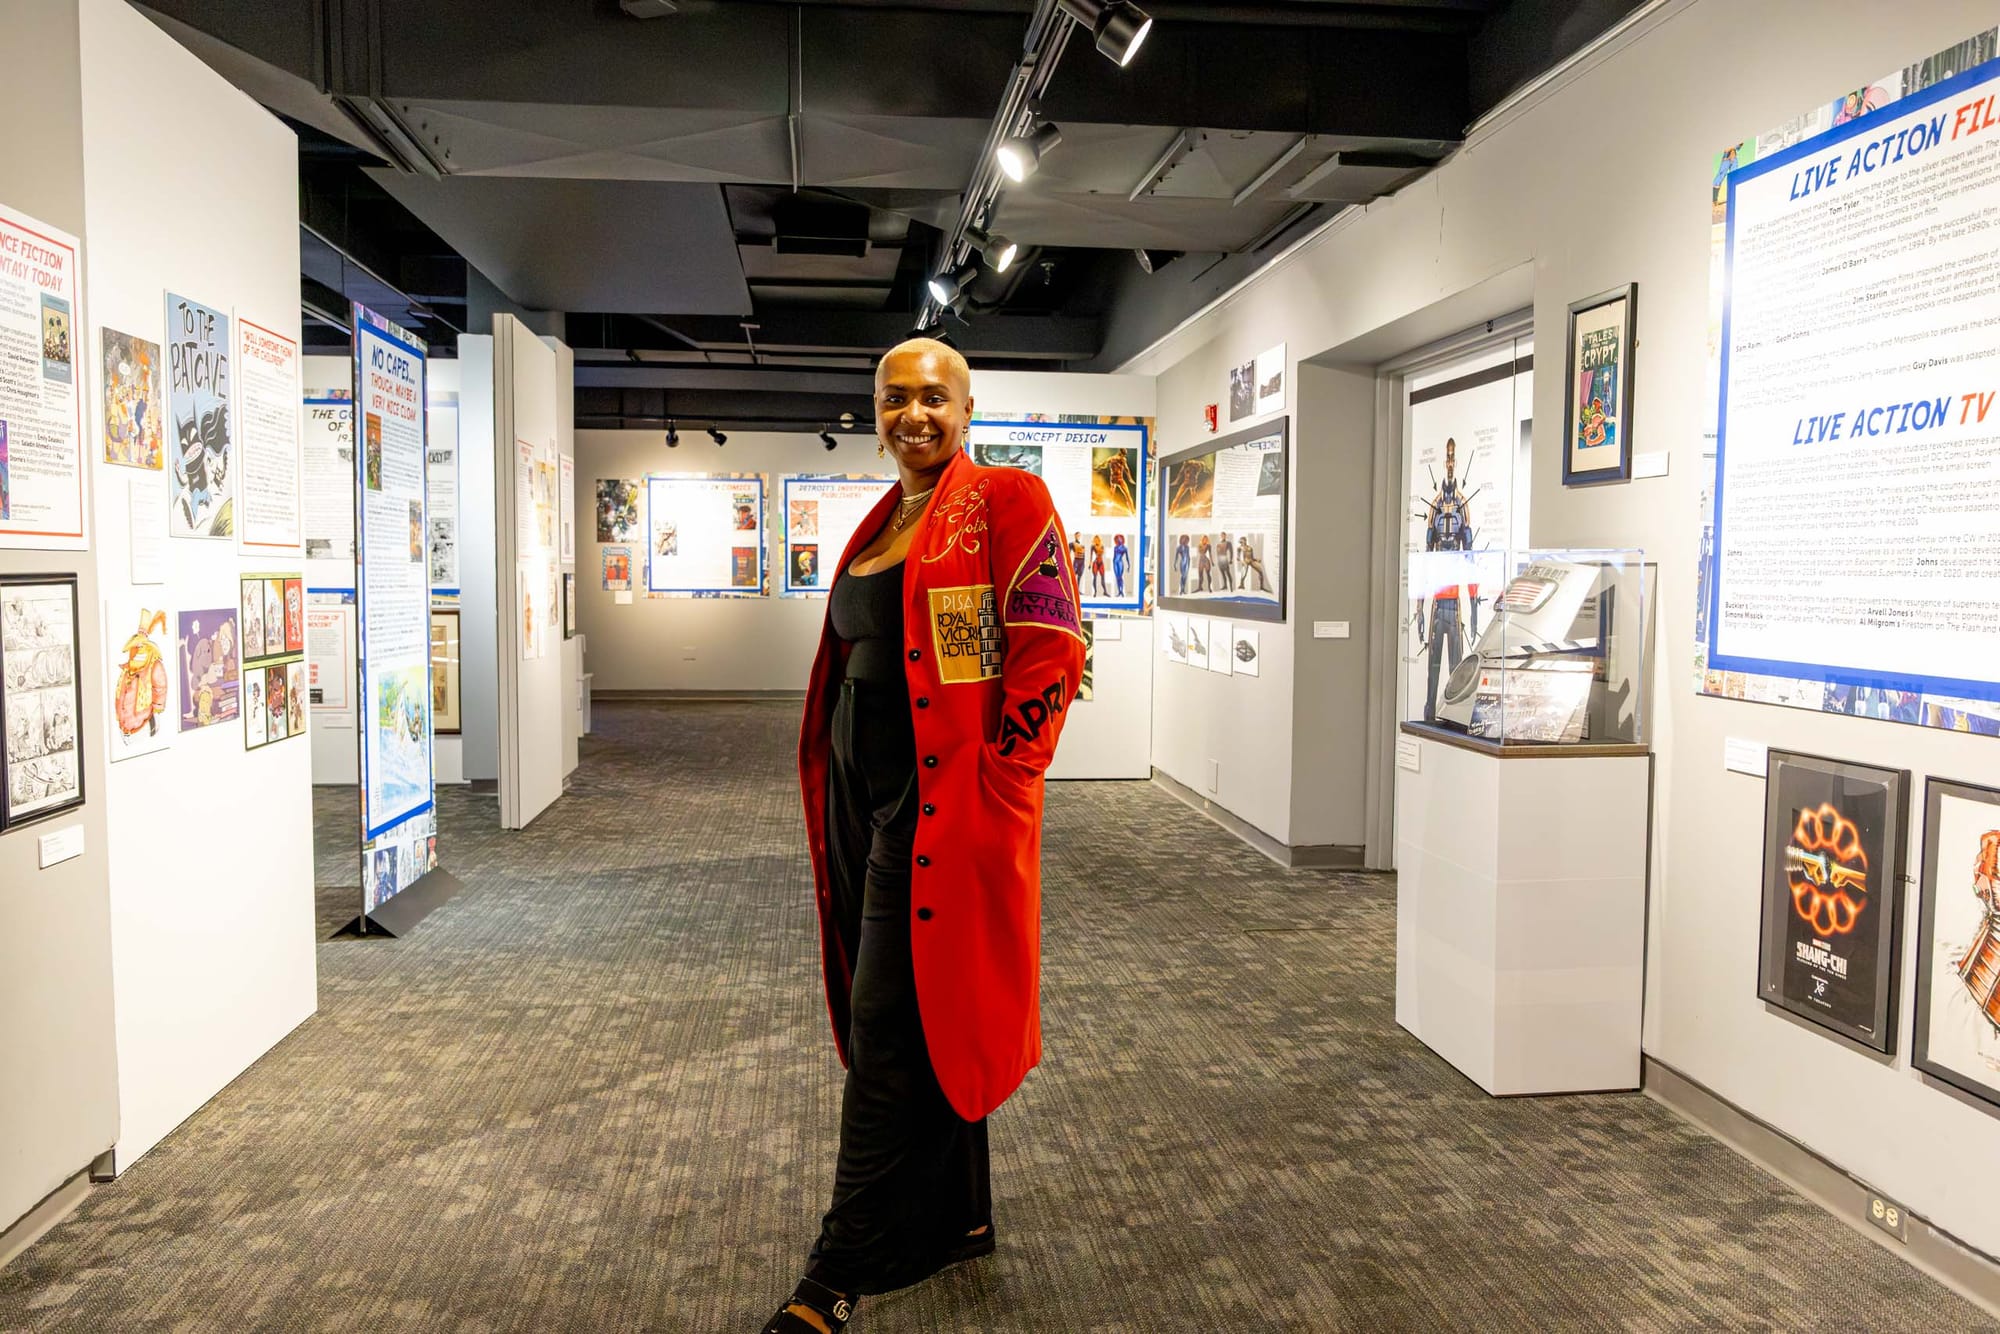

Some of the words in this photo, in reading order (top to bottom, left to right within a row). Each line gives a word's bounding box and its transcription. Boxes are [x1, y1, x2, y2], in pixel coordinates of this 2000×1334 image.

[1789, 155, 1842, 201] LIVE
[1846, 113, 1947, 180] ACTION
[1952, 94, 2000, 141] FIL
[1829, 206, 1843, 216] Tom
[21, 241, 63, 271] FICTION
[1822, 265, 1841, 276] James
[32, 267, 63, 292] TODAY
[1852, 296, 1865, 305] Jim
[177, 302, 195, 336] TO
[196, 308, 216, 347] THE
[1588, 329, 1613, 345] TALES
[371, 344, 384, 371] NO
[1584, 343, 1616, 369] CRYPT
[1912, 360, 1927, 370] Guy
[1928, 356, 1948, 367] Davis
[170, 341, 227, 399] BATCAVE
[312, 409, 335, 419] THE
[1793, 412, 1846, 446] LIVE
[1850, 396, 1952, 439] ACTION
[1960, 391, 1996, 425] TV
[328, 422, 345, 432] OF
[1009, 431, 1061, 443] CONCEPT
[1065, 432, 1107, 444] DESIGN
[1916, 557, 1938, 566] Johns
[942, 594, 976, 612] PISA
[1013, 594, 1074, 614] HOTEL
[1867, 607, 1887, 616] Arvell
[937, 611, 972, 628] ROYAL
[941, 641, 980, 657] HOTEL
[1796, 941, 1848, 976] SHANG-CHI
